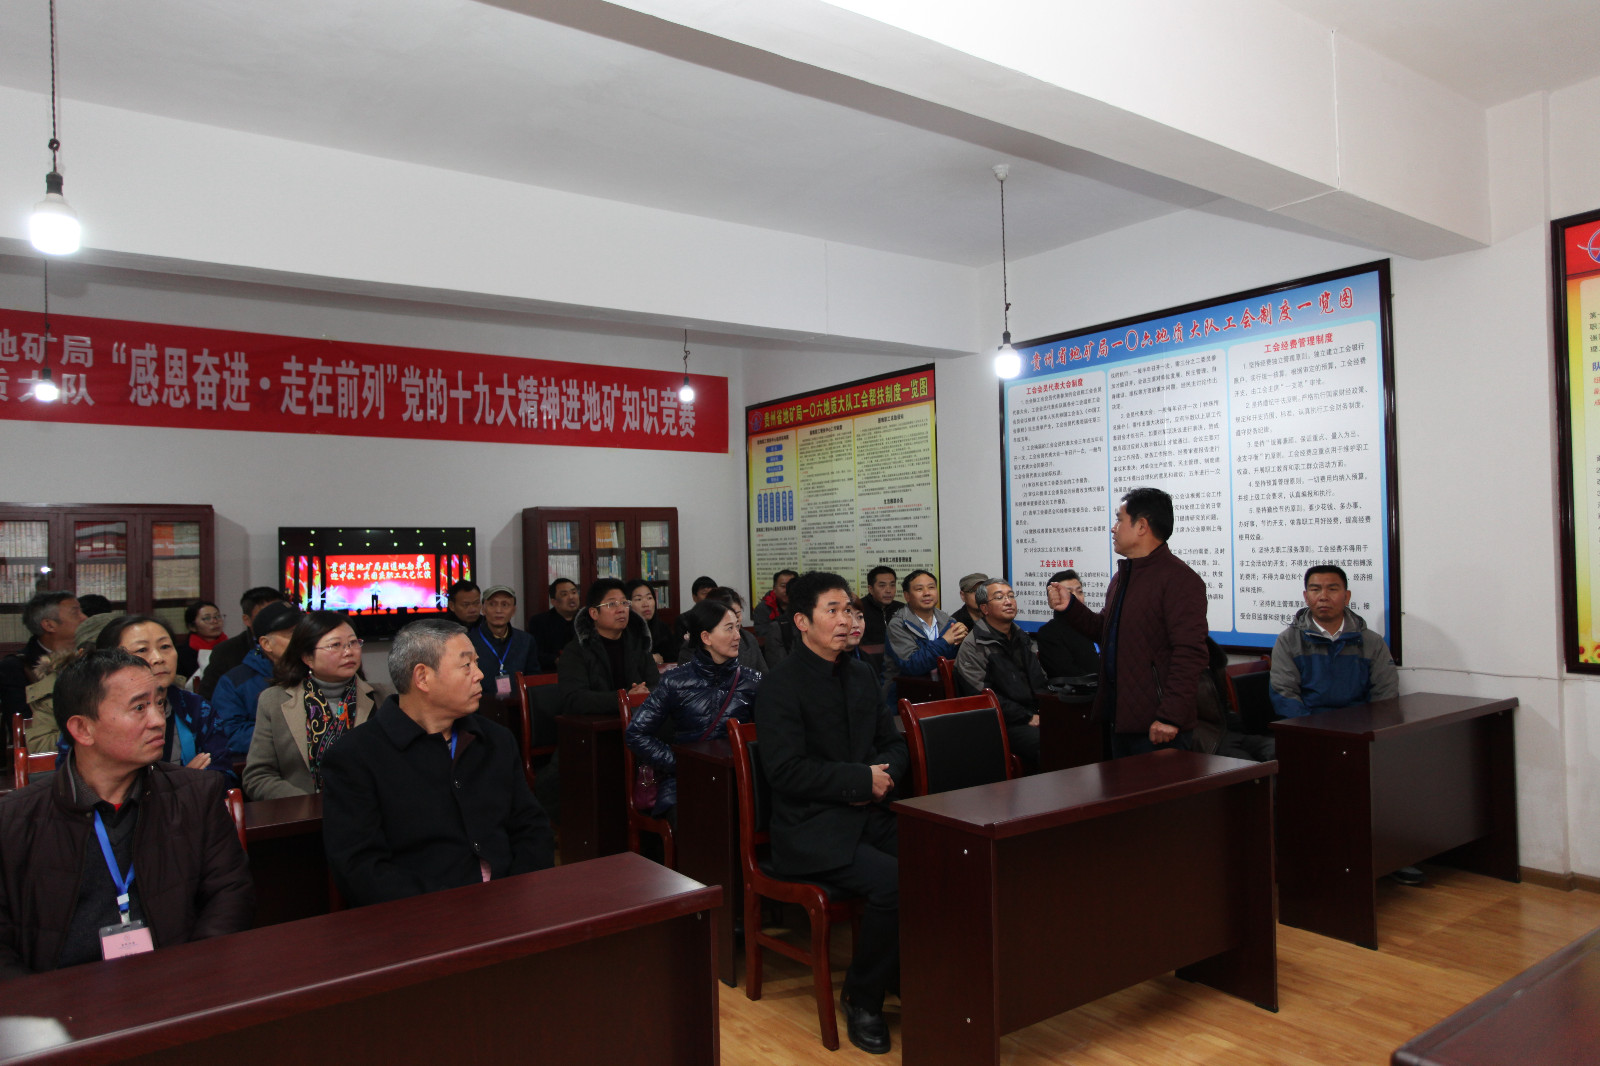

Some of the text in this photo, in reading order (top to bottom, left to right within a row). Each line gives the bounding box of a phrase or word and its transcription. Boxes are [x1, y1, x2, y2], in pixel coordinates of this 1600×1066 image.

[1264, 333, 1333, 353] 工会经费管理制度
[1040, 560, 1074, 568] 工会会议制度
